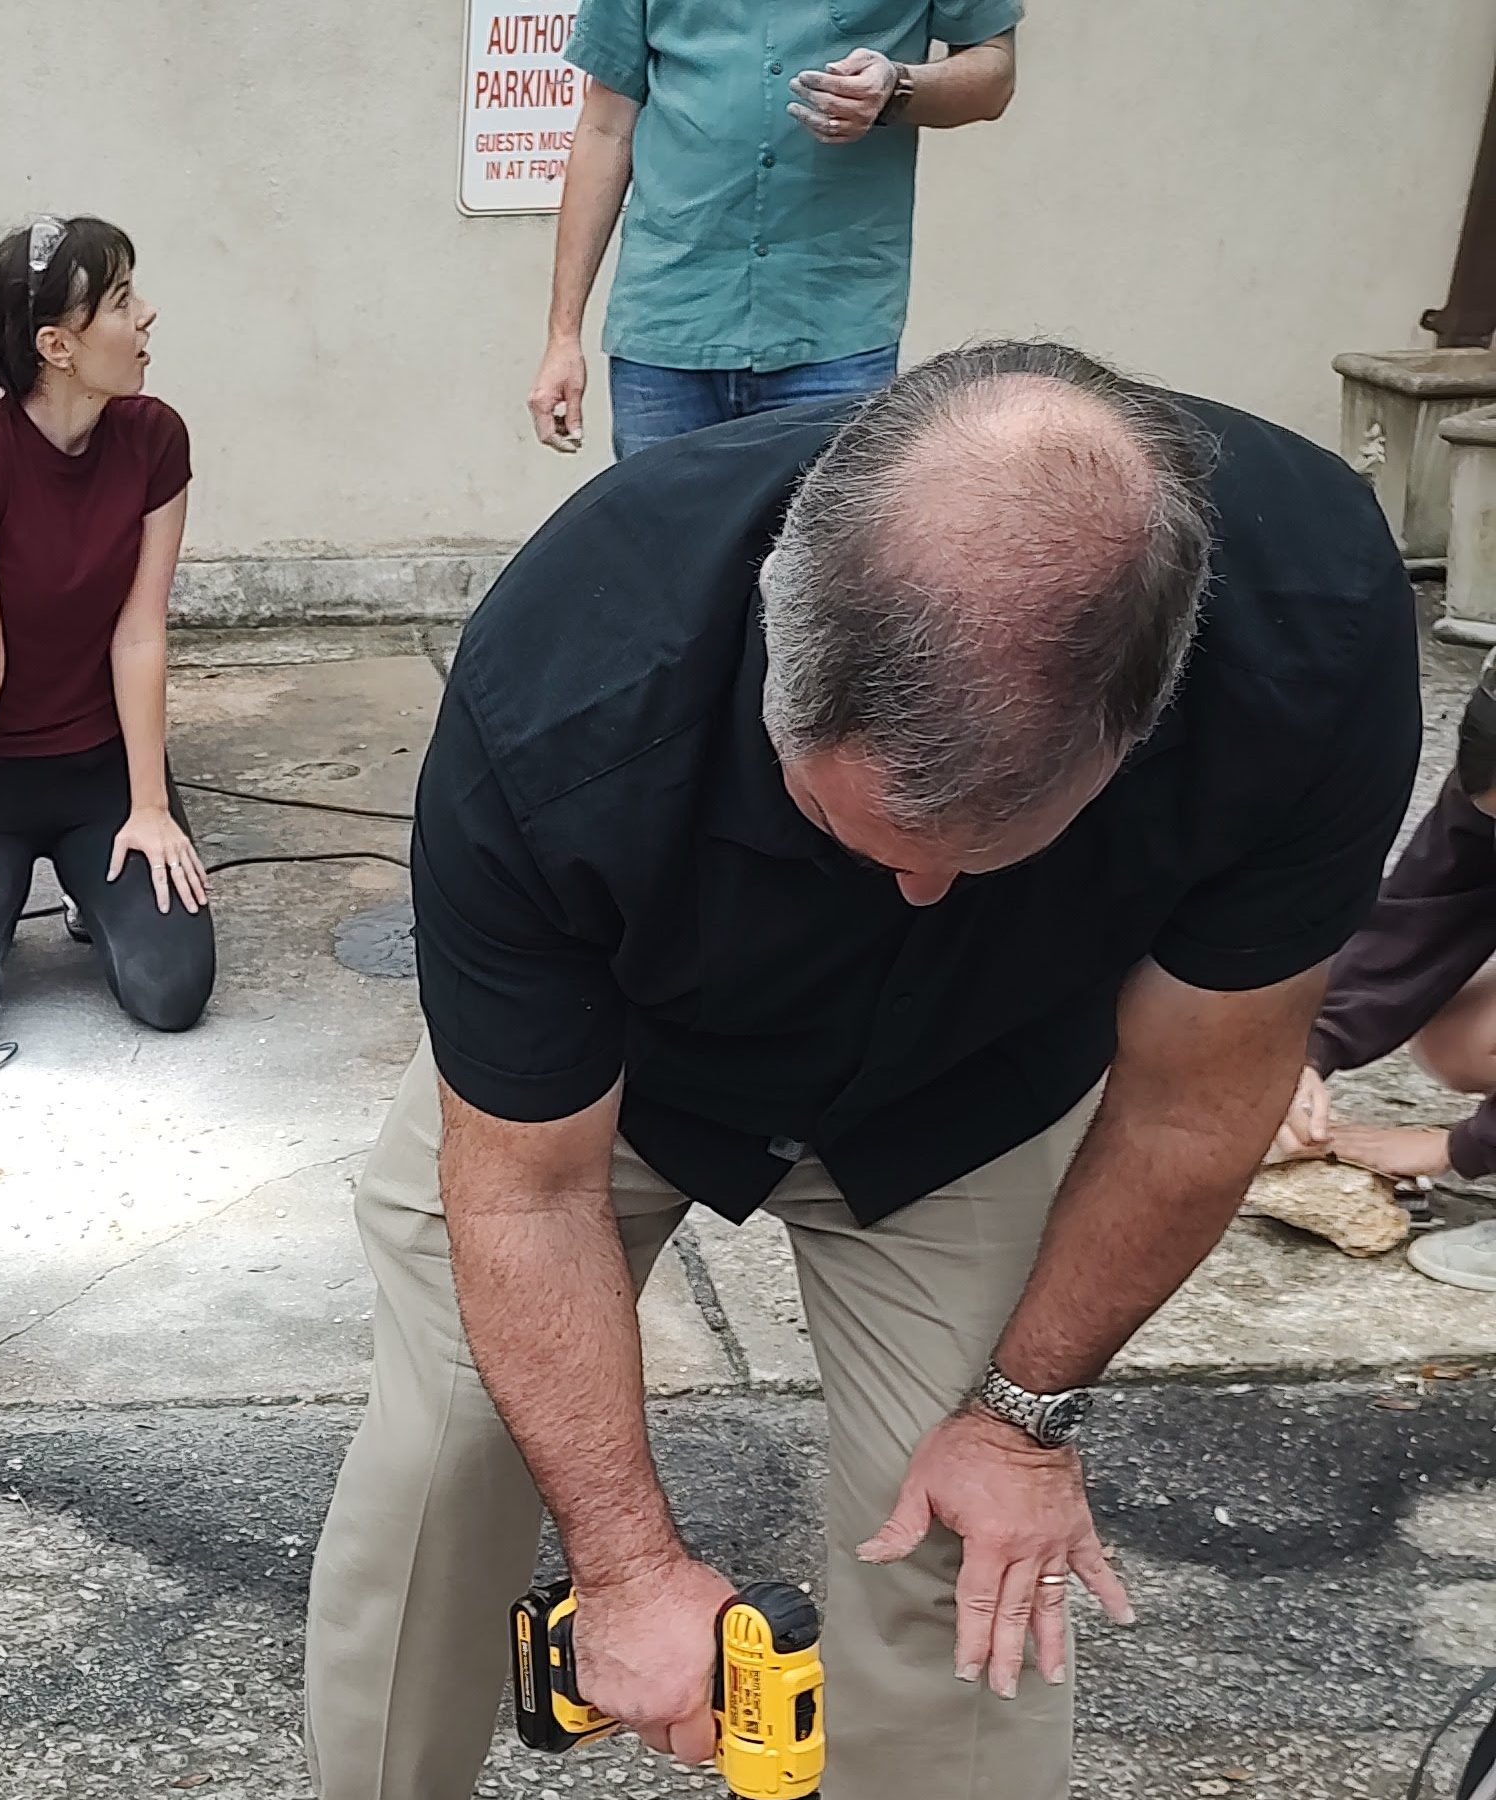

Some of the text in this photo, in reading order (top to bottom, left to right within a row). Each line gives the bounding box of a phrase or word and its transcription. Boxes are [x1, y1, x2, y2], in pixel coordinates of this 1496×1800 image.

[475, 68, 574, 109] PARKING
[476, 132, 534, 152] GUESTS
[486, 161, 501, 180] IN
[506, 160, 524, 179] AT
